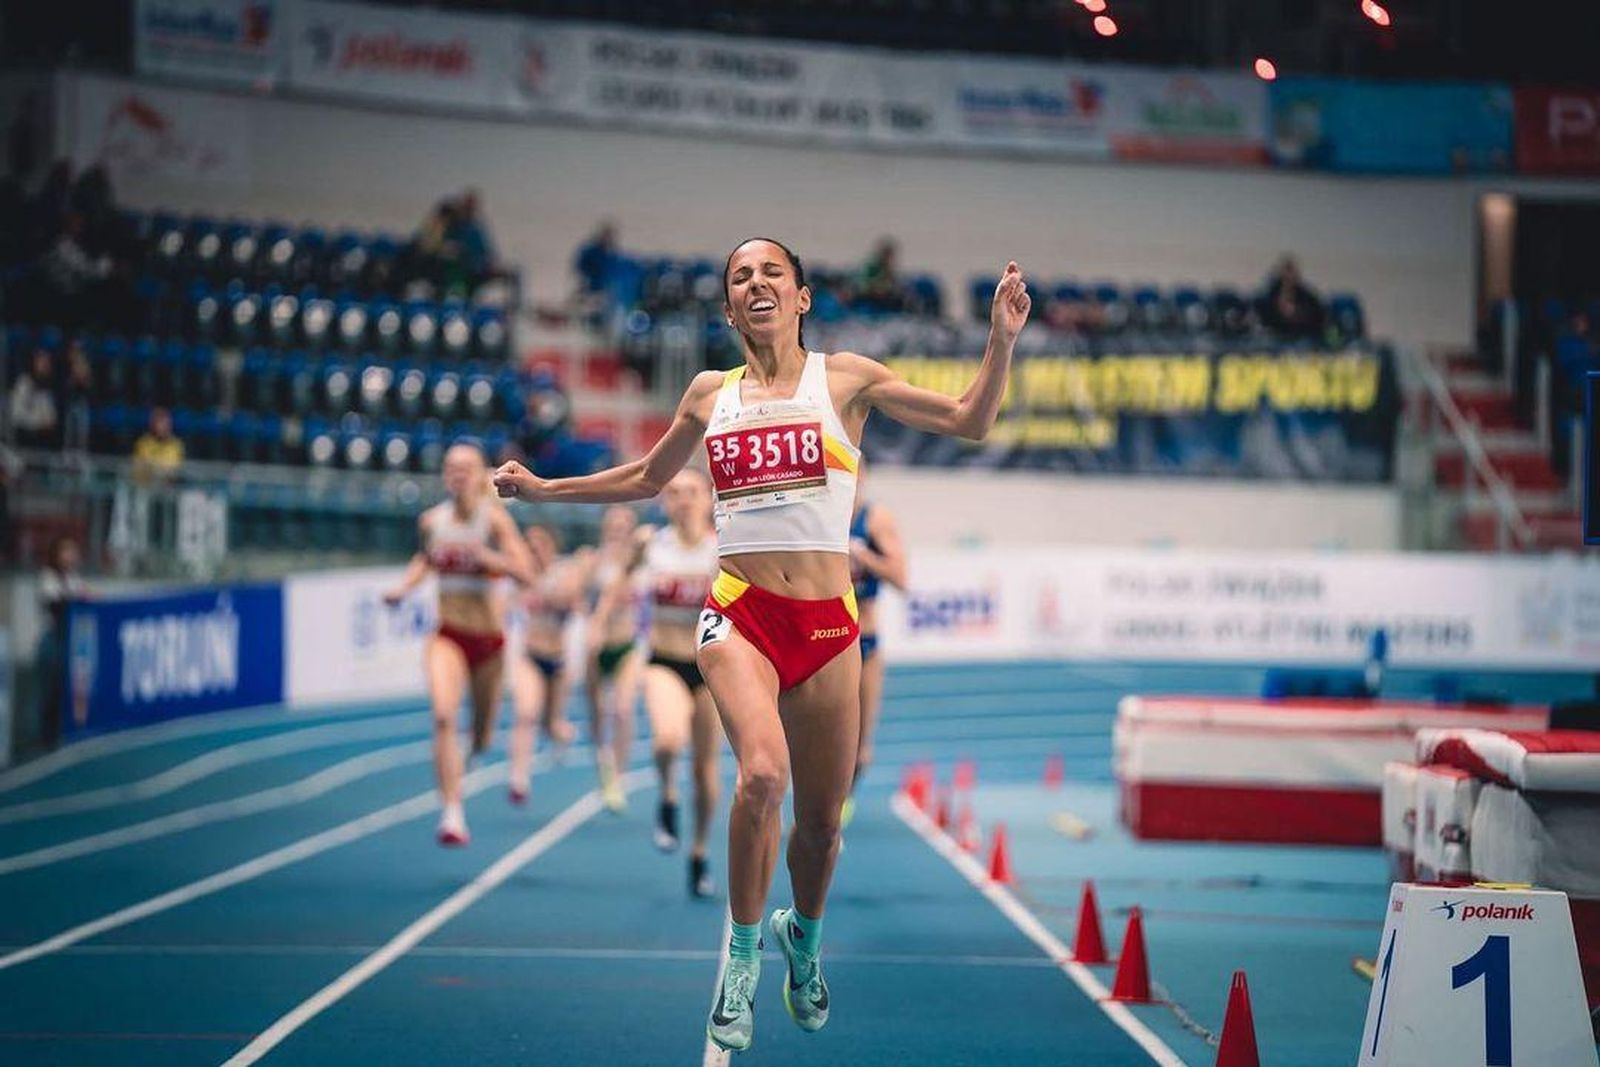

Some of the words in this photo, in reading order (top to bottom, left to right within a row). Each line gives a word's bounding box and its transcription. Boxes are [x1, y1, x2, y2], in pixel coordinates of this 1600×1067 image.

[710, 436, 741, 462] 35
[746, 428, 819, 470] 3518
[720, 461, 736, 477] W
[701, 612, 723, 645] 2
[1451, 934, 1512, 1067] 1
